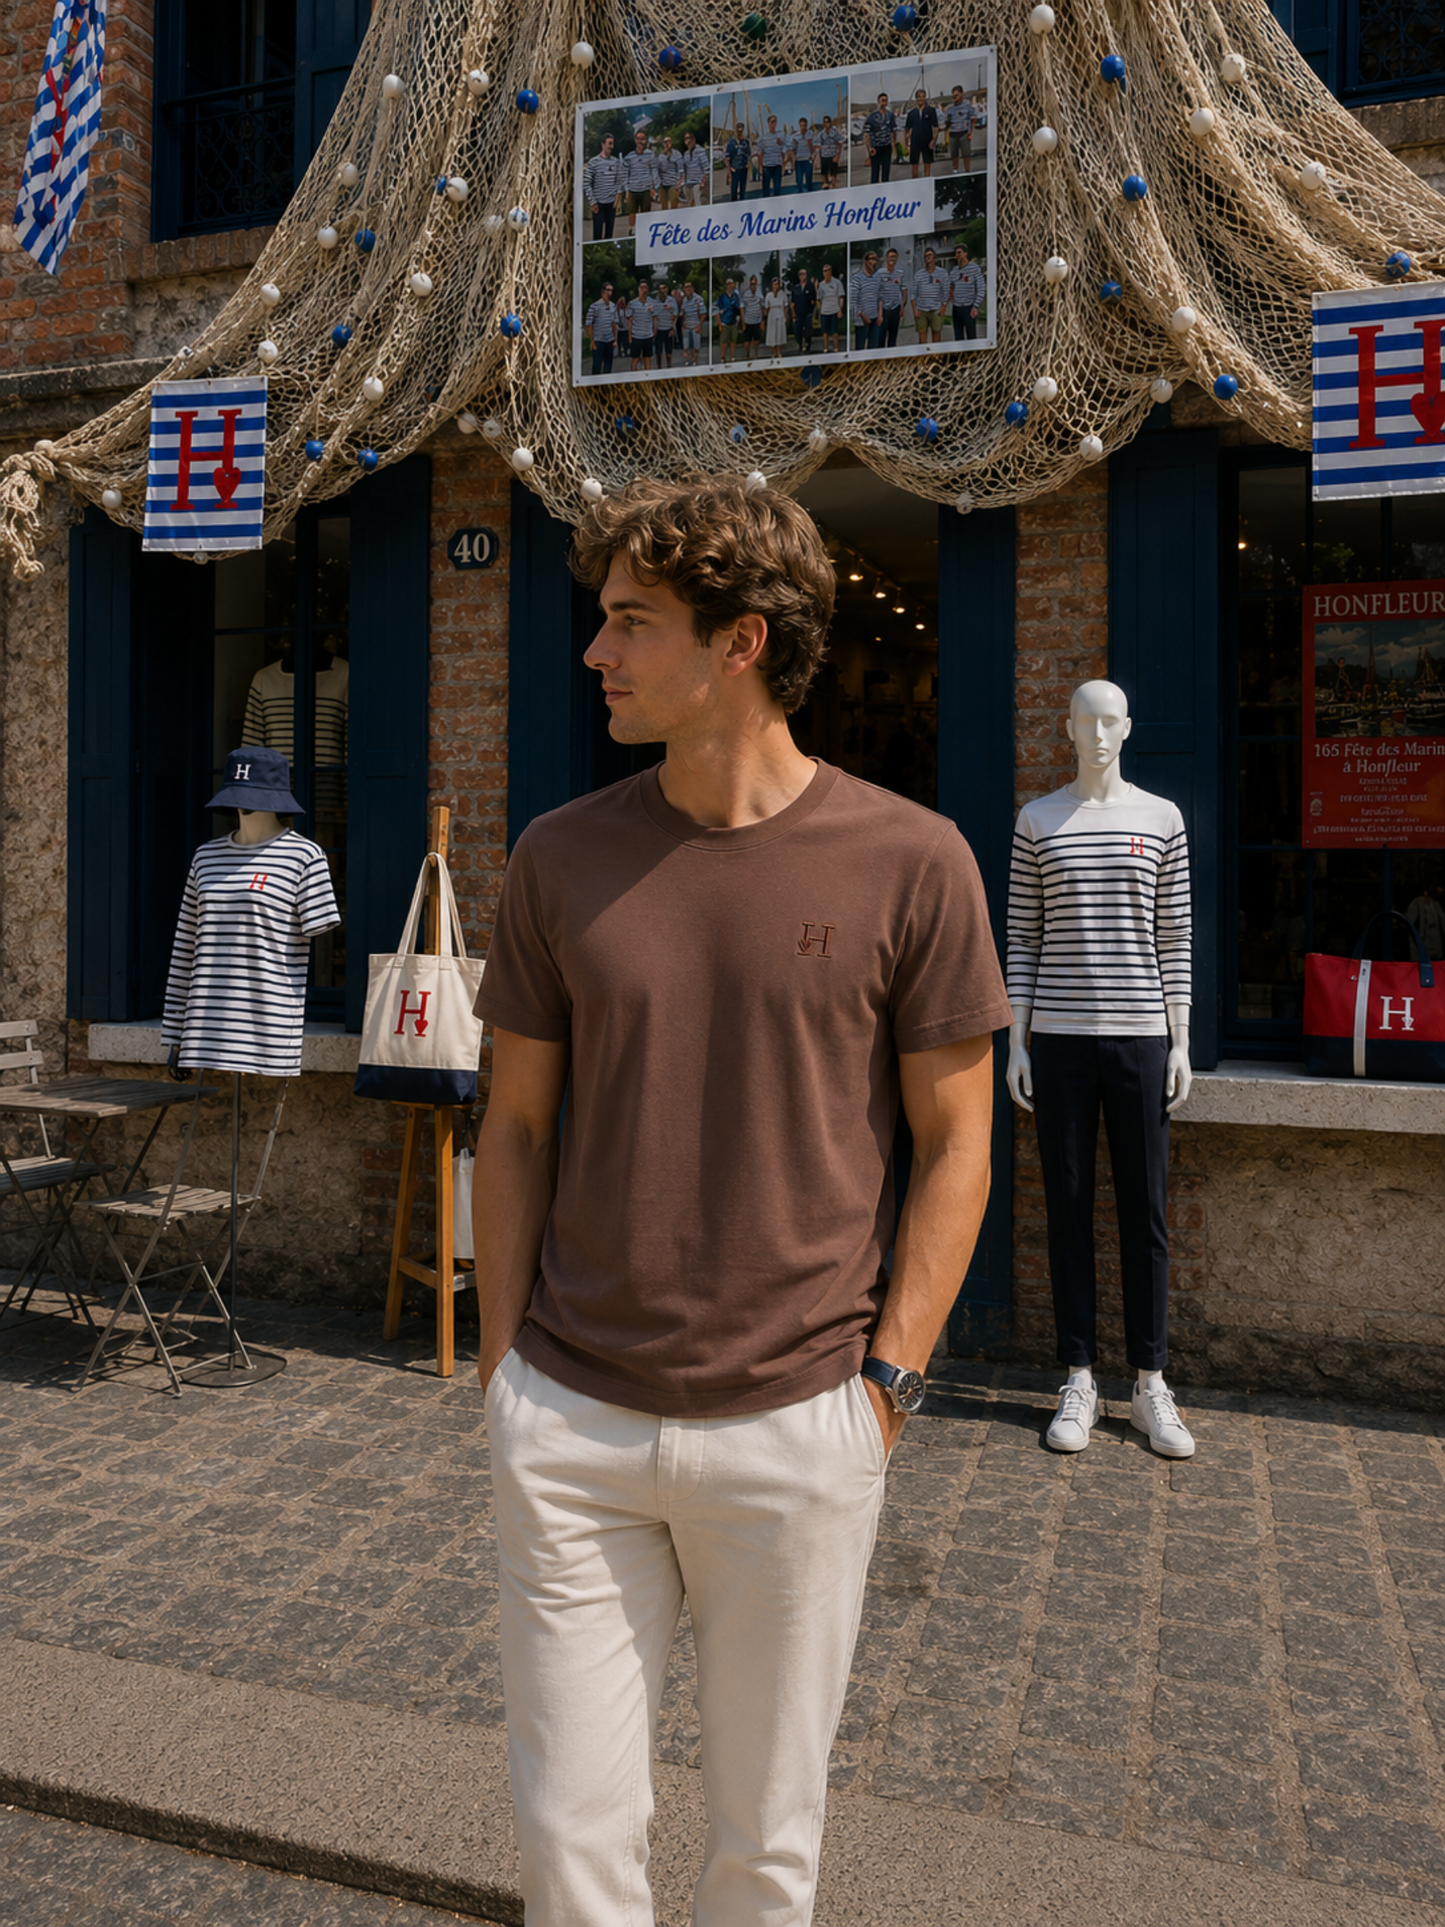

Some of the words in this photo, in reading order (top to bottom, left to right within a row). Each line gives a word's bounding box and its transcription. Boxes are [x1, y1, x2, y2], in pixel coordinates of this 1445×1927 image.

[648, 221, 691, 247] Fête
[697, 218, 733, 241] des
[737, 210, 818, 239] Marins
[823, 197, 921, 230] Honfleur
[1349, 319, 1445, 449] H
[170, 408, 242, 511] H
[454, 533, 490, 563] 40
[1313, 591, 1445, 617] HONFLEUR
[1377, 742, 1400, 756] des
[234, 763, 251, 780] H
[1356, 758, 1421, 777] Honfleur
[249, 872, 268, 891] H
[797, 921, 835, 958] H
[393, 990, 431, 1037] H
[1379, 995, 1414, 1031] H
